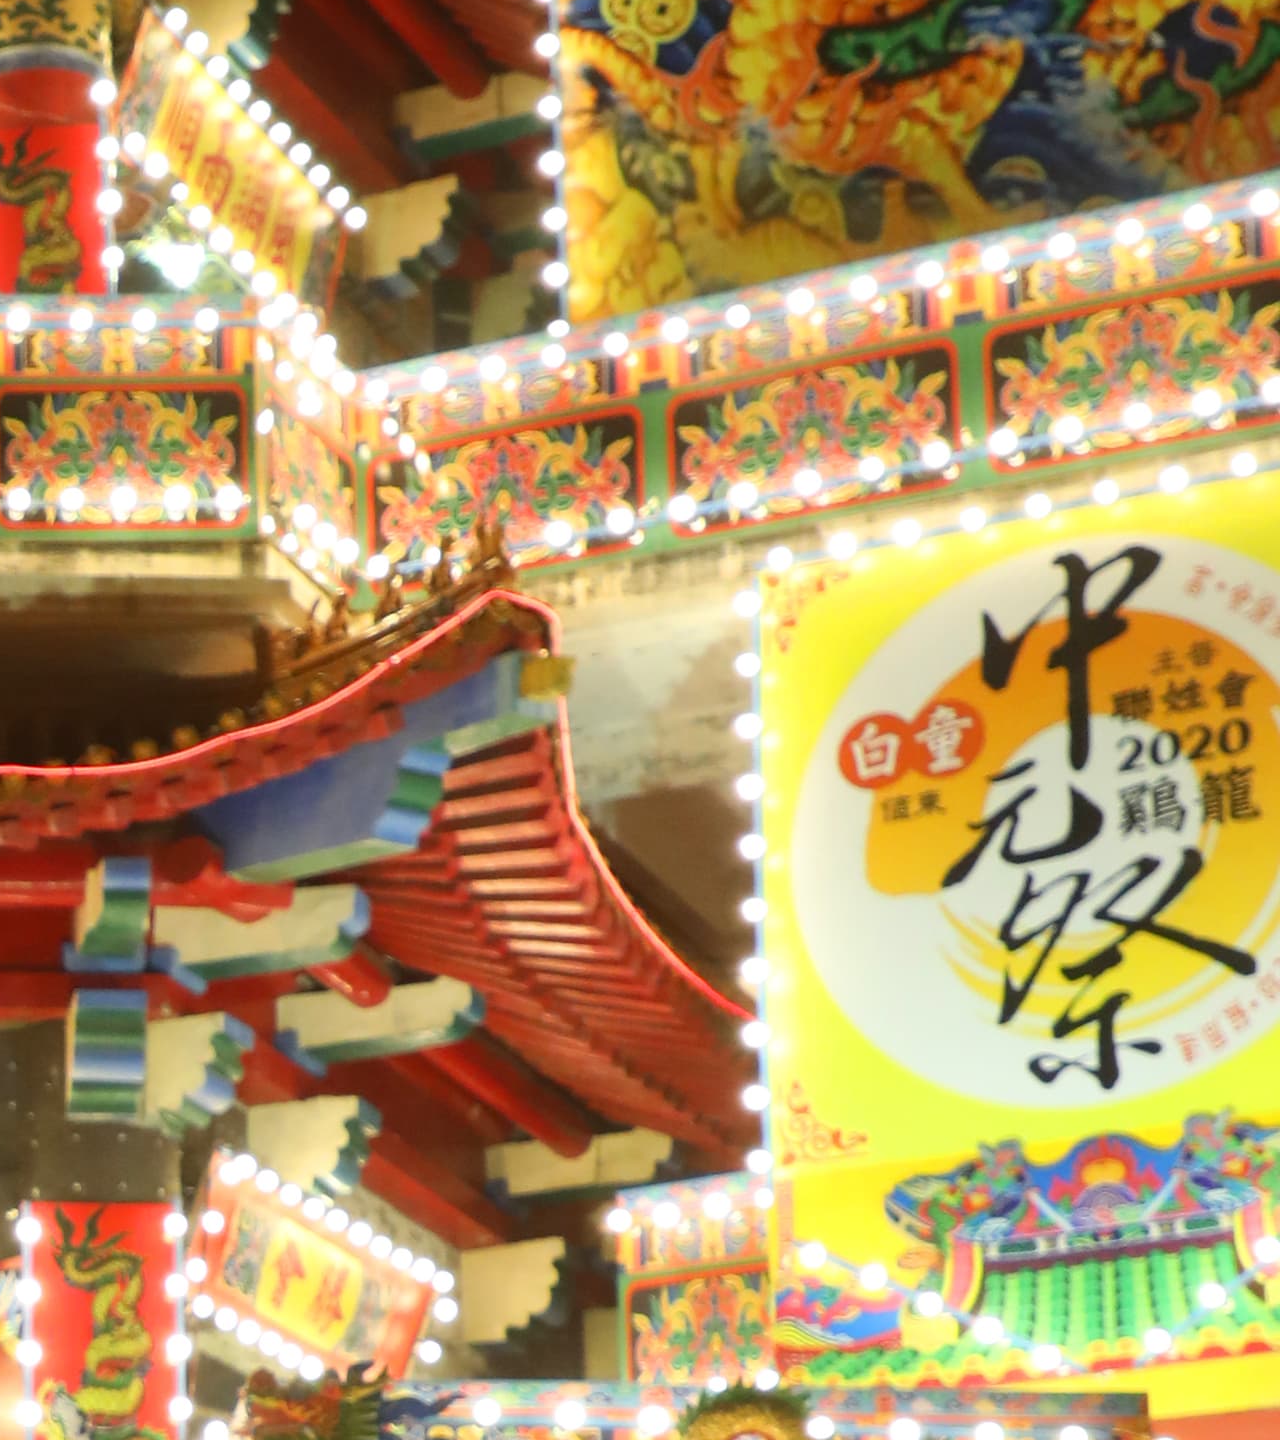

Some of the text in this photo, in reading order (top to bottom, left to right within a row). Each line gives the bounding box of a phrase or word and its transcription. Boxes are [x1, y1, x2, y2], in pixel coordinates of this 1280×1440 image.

[1151, 640, 1218, 674] 主普
[1111, 670, 1255, 720] 聯姓會
[851, 704, 973, 781] 白童
[1117, 718, 1251, 772] 2020
[942, 546, 1256, 1090] 中元祭
